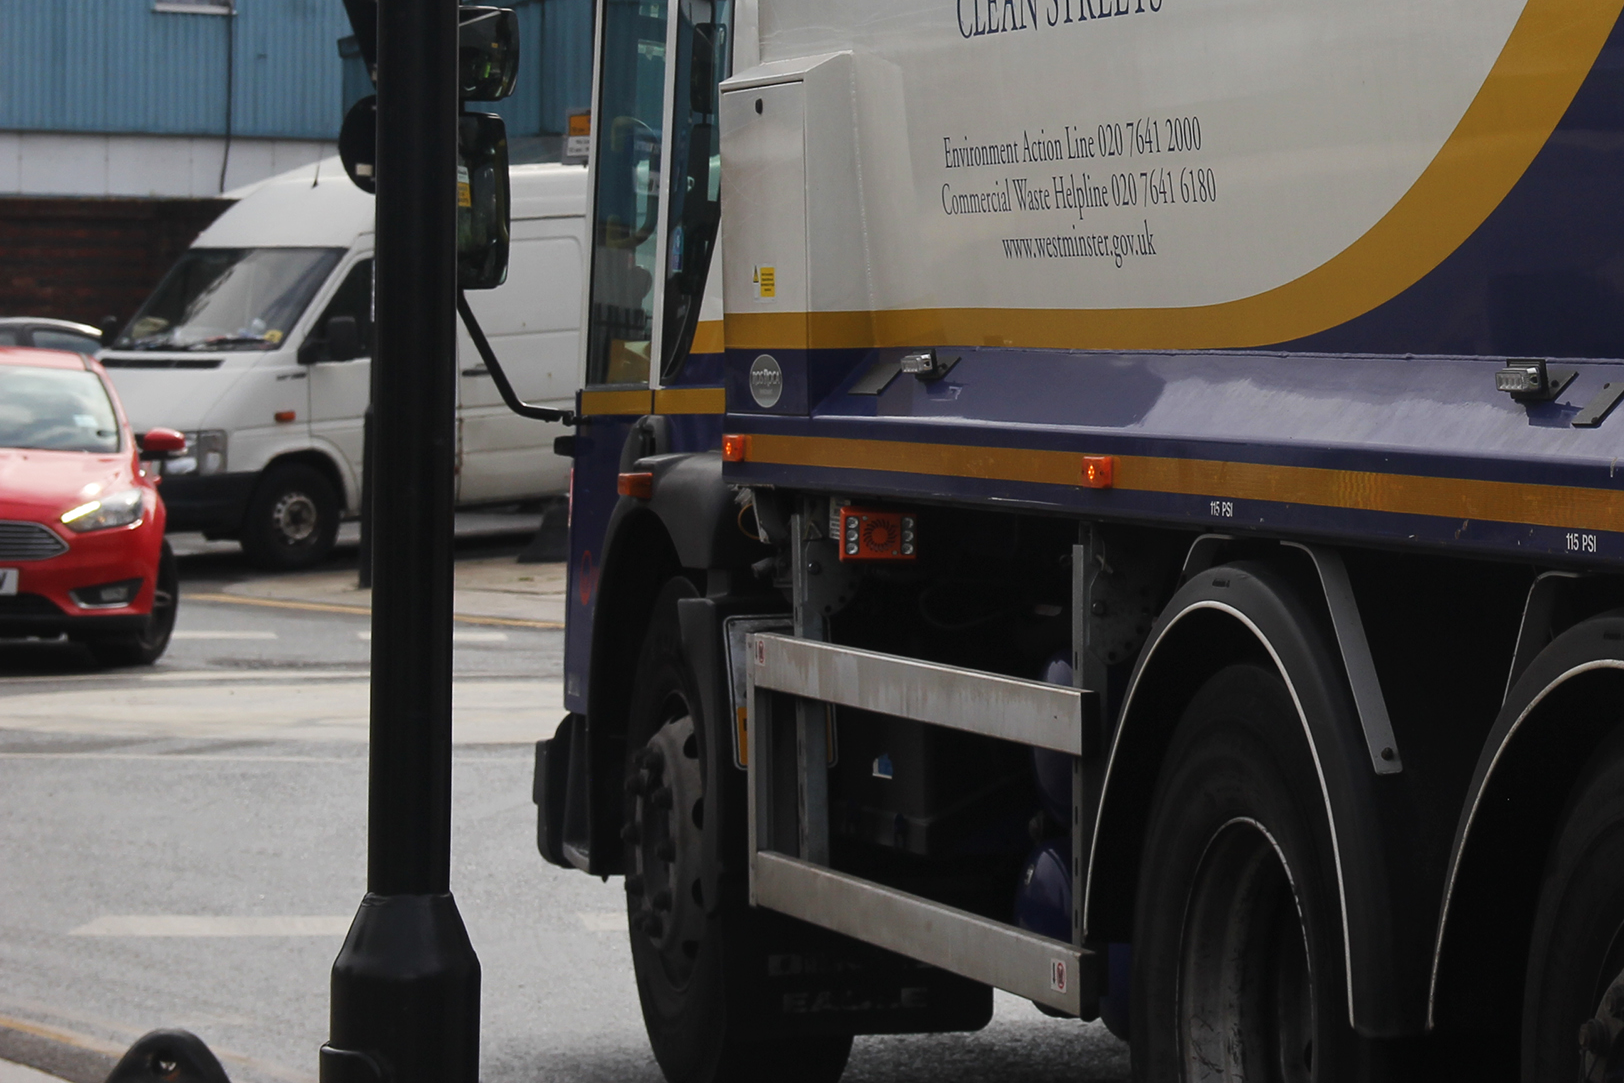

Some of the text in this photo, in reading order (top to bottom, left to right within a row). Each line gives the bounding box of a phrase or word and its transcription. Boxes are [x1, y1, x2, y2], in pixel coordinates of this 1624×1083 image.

[943, 116, 1202, 169] Environment Action Line 020 7641 2000
[941, 166, 1217, 221] Commercial Waste Helpline 020 7641 6180
[1001, 219, 1157, 269] www.westminster.gov.uk
[1210, 500, 1234, 518] 115 PSI
[1565, 532, 1597, 553] 115 PSI
